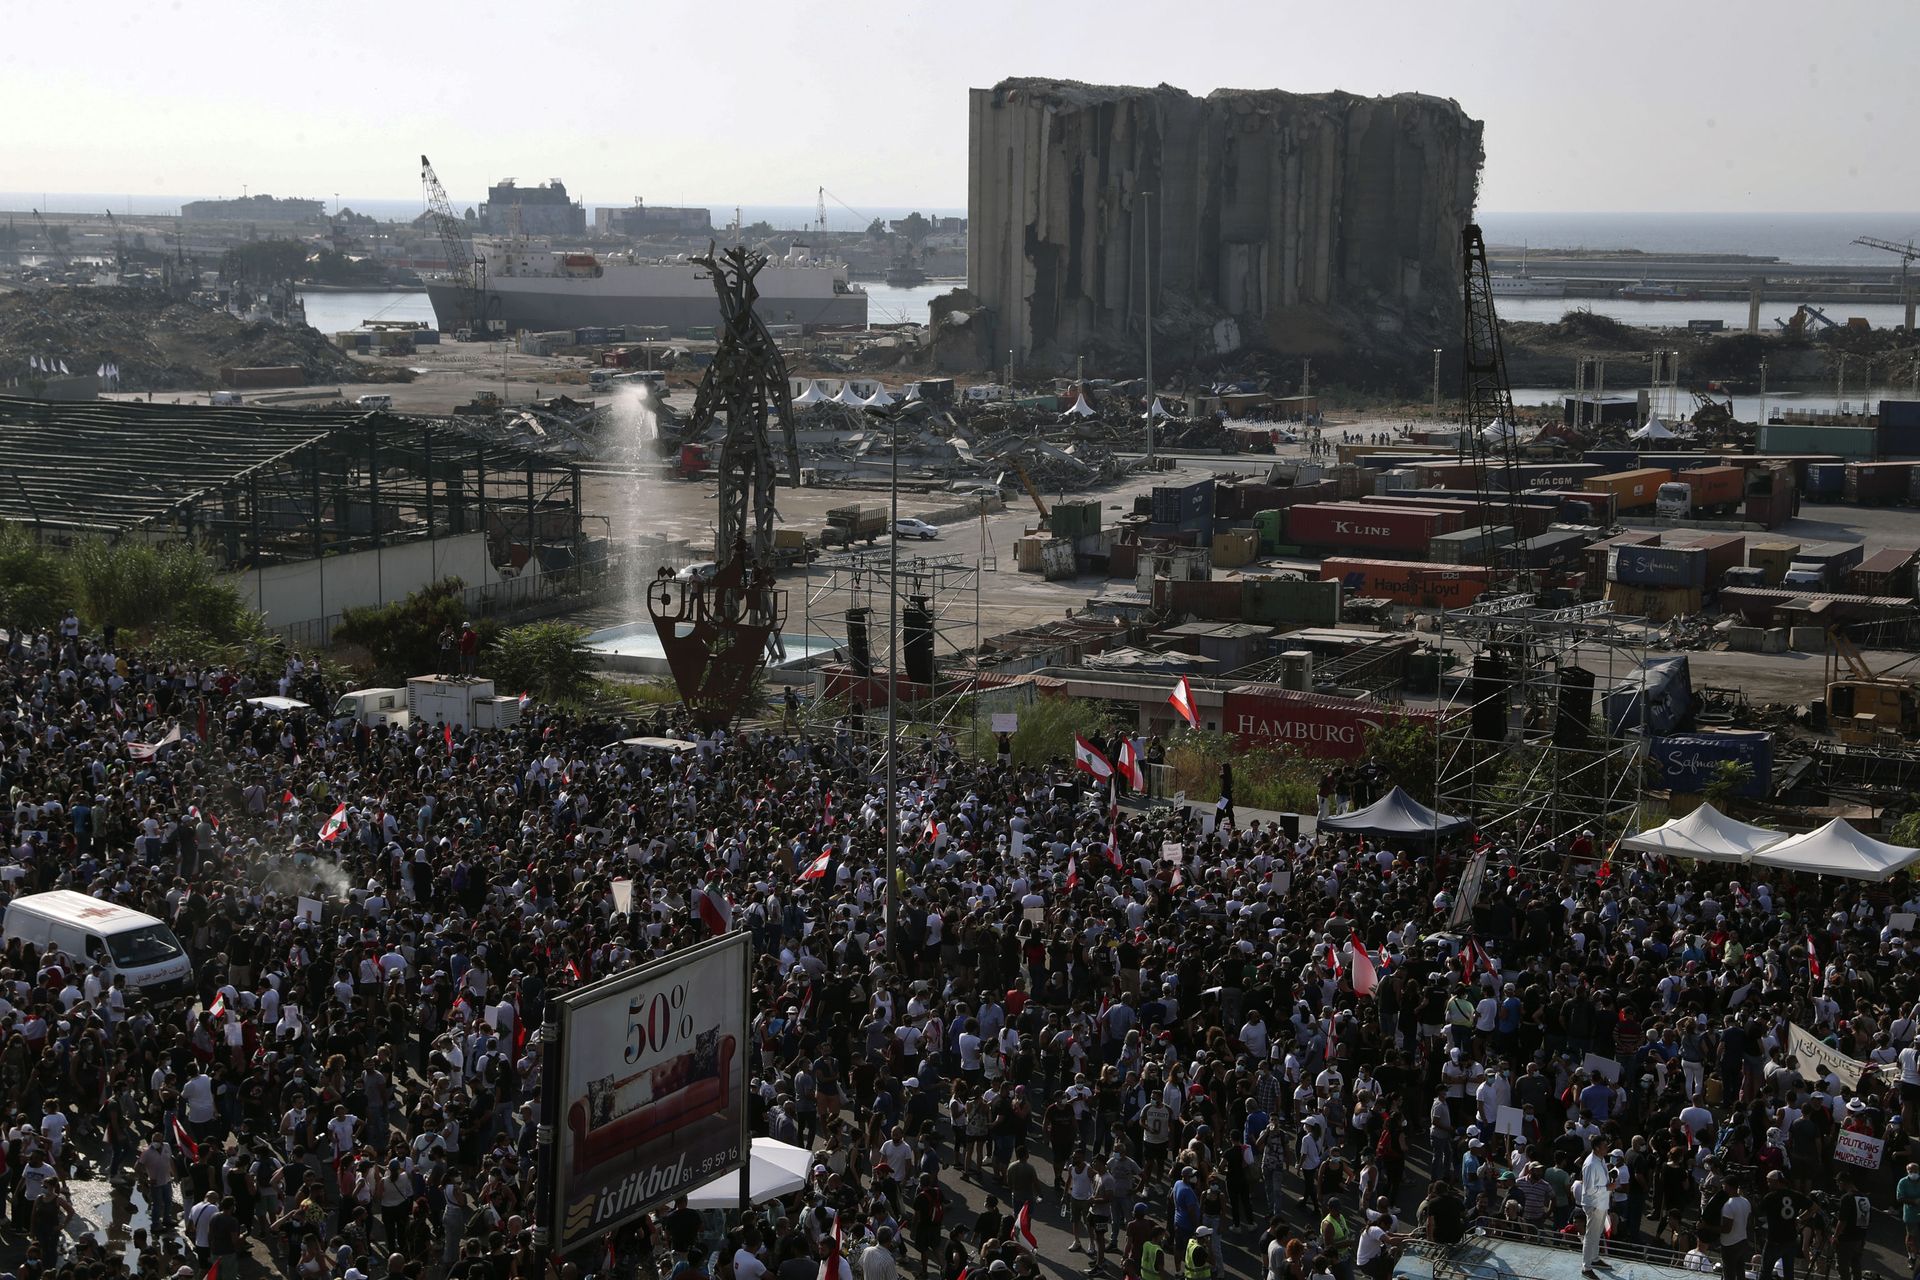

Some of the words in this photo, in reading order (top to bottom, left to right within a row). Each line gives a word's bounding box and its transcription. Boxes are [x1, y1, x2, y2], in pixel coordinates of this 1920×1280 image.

[1530, 478, 1550, 486] CMA
[1552, 476, 1573, 485] CGM
[1354, 525, 1391, 536] LINE
[1374, 577, 1459, 597] Hapag-Lloyd
[1237, 713, 1356, 744] HAMBURG
[624, 979, 693, 1065] 50%
[1839, 1135, 1880, 1154] POLITICIANS
[682, 1168, 693, 1183] 81
[702, 1157, 713, 1174] 59
[715, 1153, 726, 1167] 59
[728, 1146, 738, 1161] 16
[1834, 1150, 1878, 1169] MURDERERS
[594, 1152, 687, 1225] istikbal
[1781, 1196, 1795, 1220] 8
